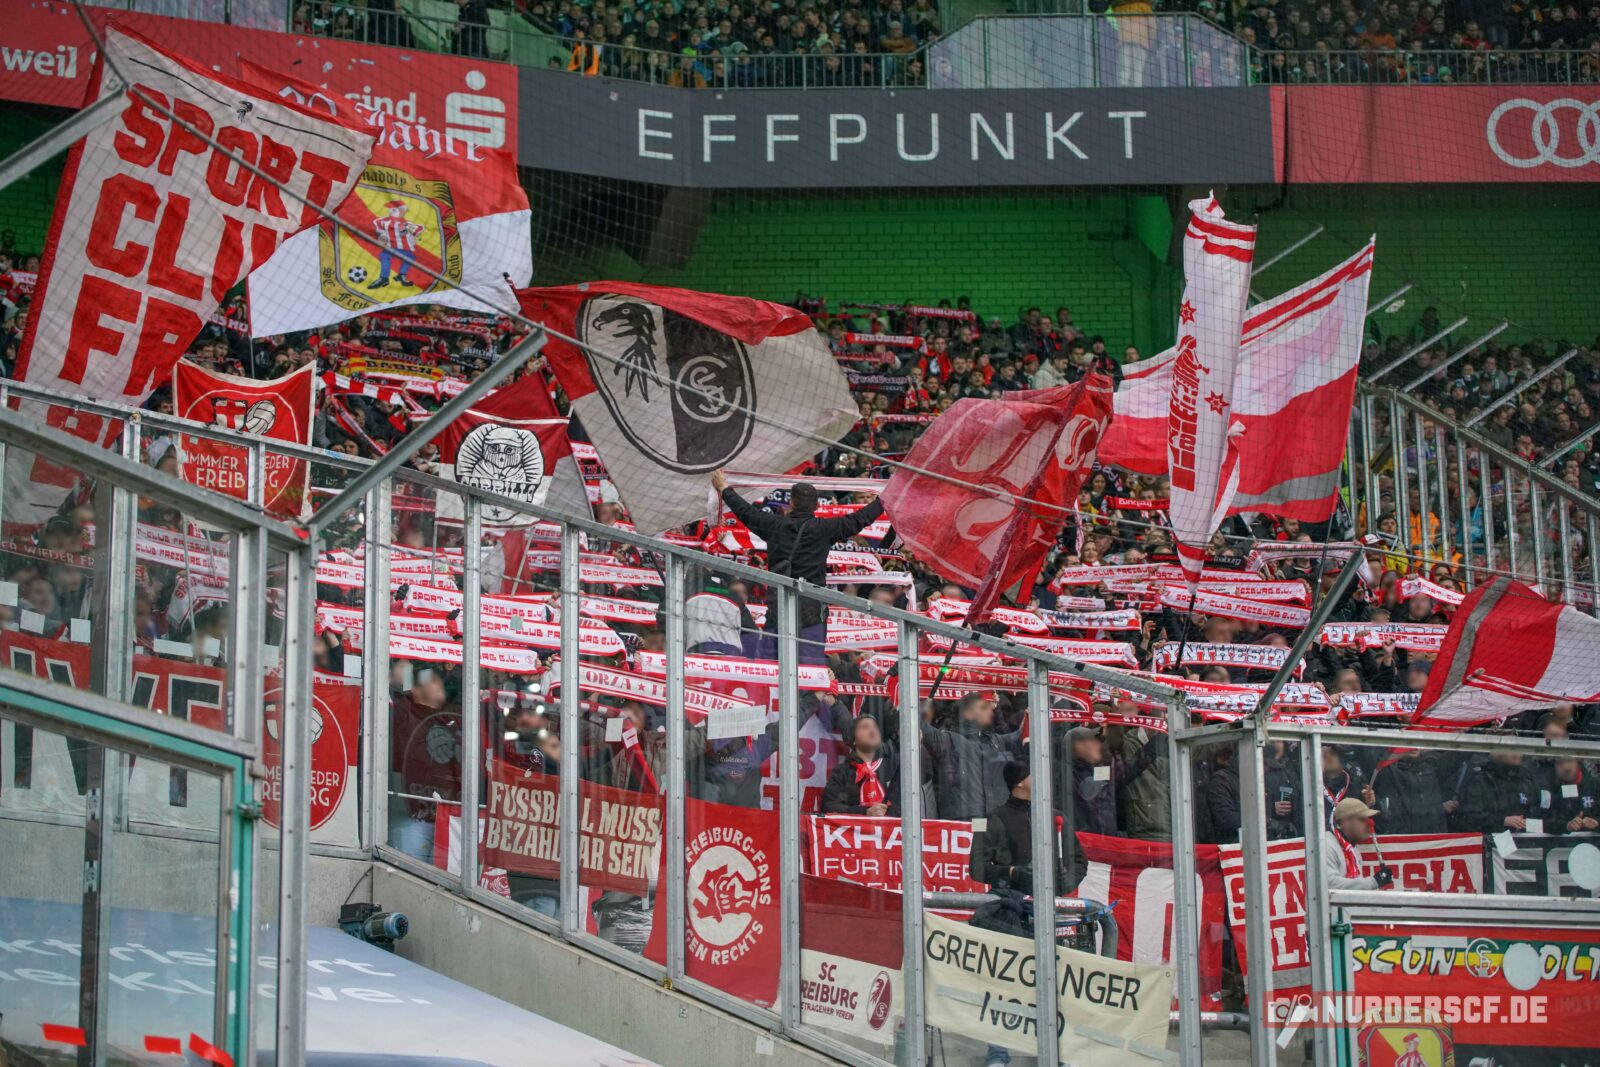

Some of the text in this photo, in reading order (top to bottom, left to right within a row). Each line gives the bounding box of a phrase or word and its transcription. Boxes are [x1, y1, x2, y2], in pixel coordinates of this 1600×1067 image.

[1, 44, 78, 79] weil
[114, 83, 350, 232] SPORT
[637, 108, 1148, 162] EFFPUNKT
[490, 781, 660, 843] FUSSBL MUSS
[823, 853, 879, 875] FÜR
[711, 920, 764, 966] RECHTS
[818, 961, 838, 983] SC
[926, 929, 1142, 1011] GRENZGNGER
